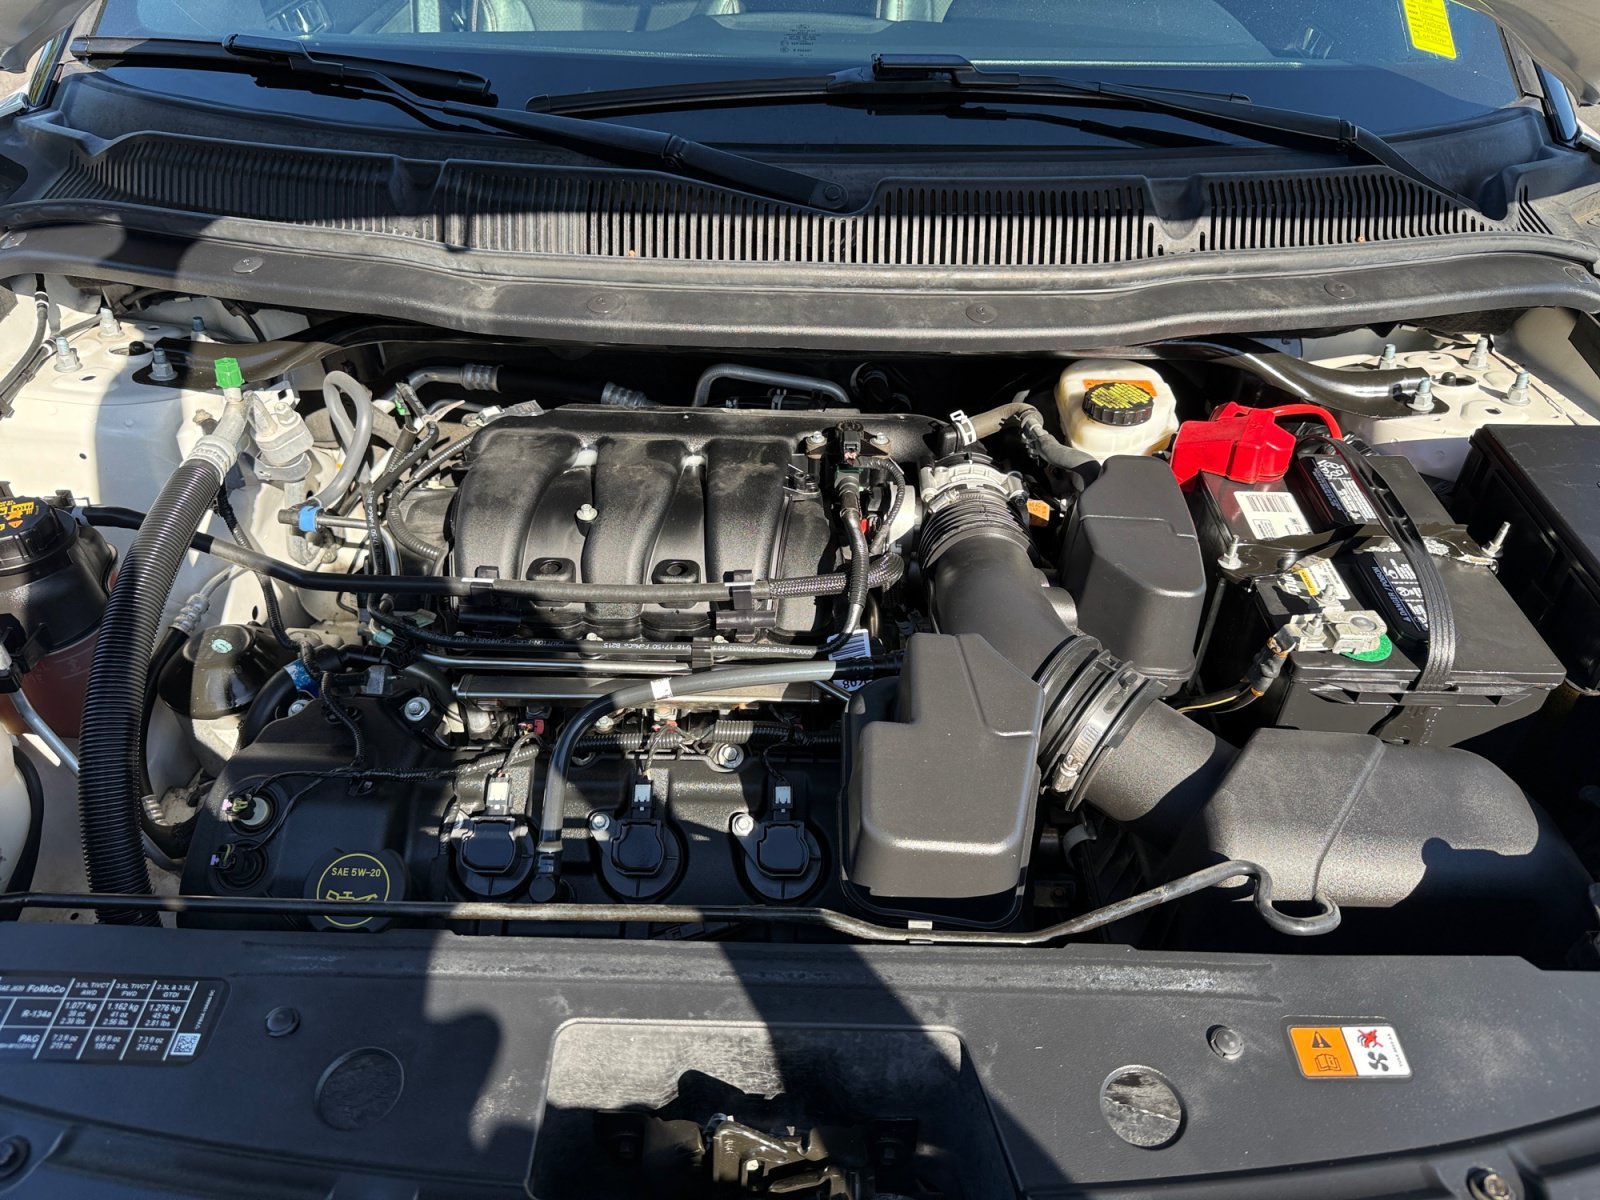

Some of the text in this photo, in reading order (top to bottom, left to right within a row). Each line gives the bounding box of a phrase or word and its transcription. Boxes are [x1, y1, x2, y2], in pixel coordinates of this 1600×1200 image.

[331, 867, 381, 877] SAE 5W-20
[26, 983, 66, 993] FoMoCo
[64, 1001, 97, 1012] 1.077 kg
[107, 1002, 140, 1013] 1.162 kg
[149, 1003, 181, 1014] 1.276 kg
[18, 1033, 40, 1043] PAG
